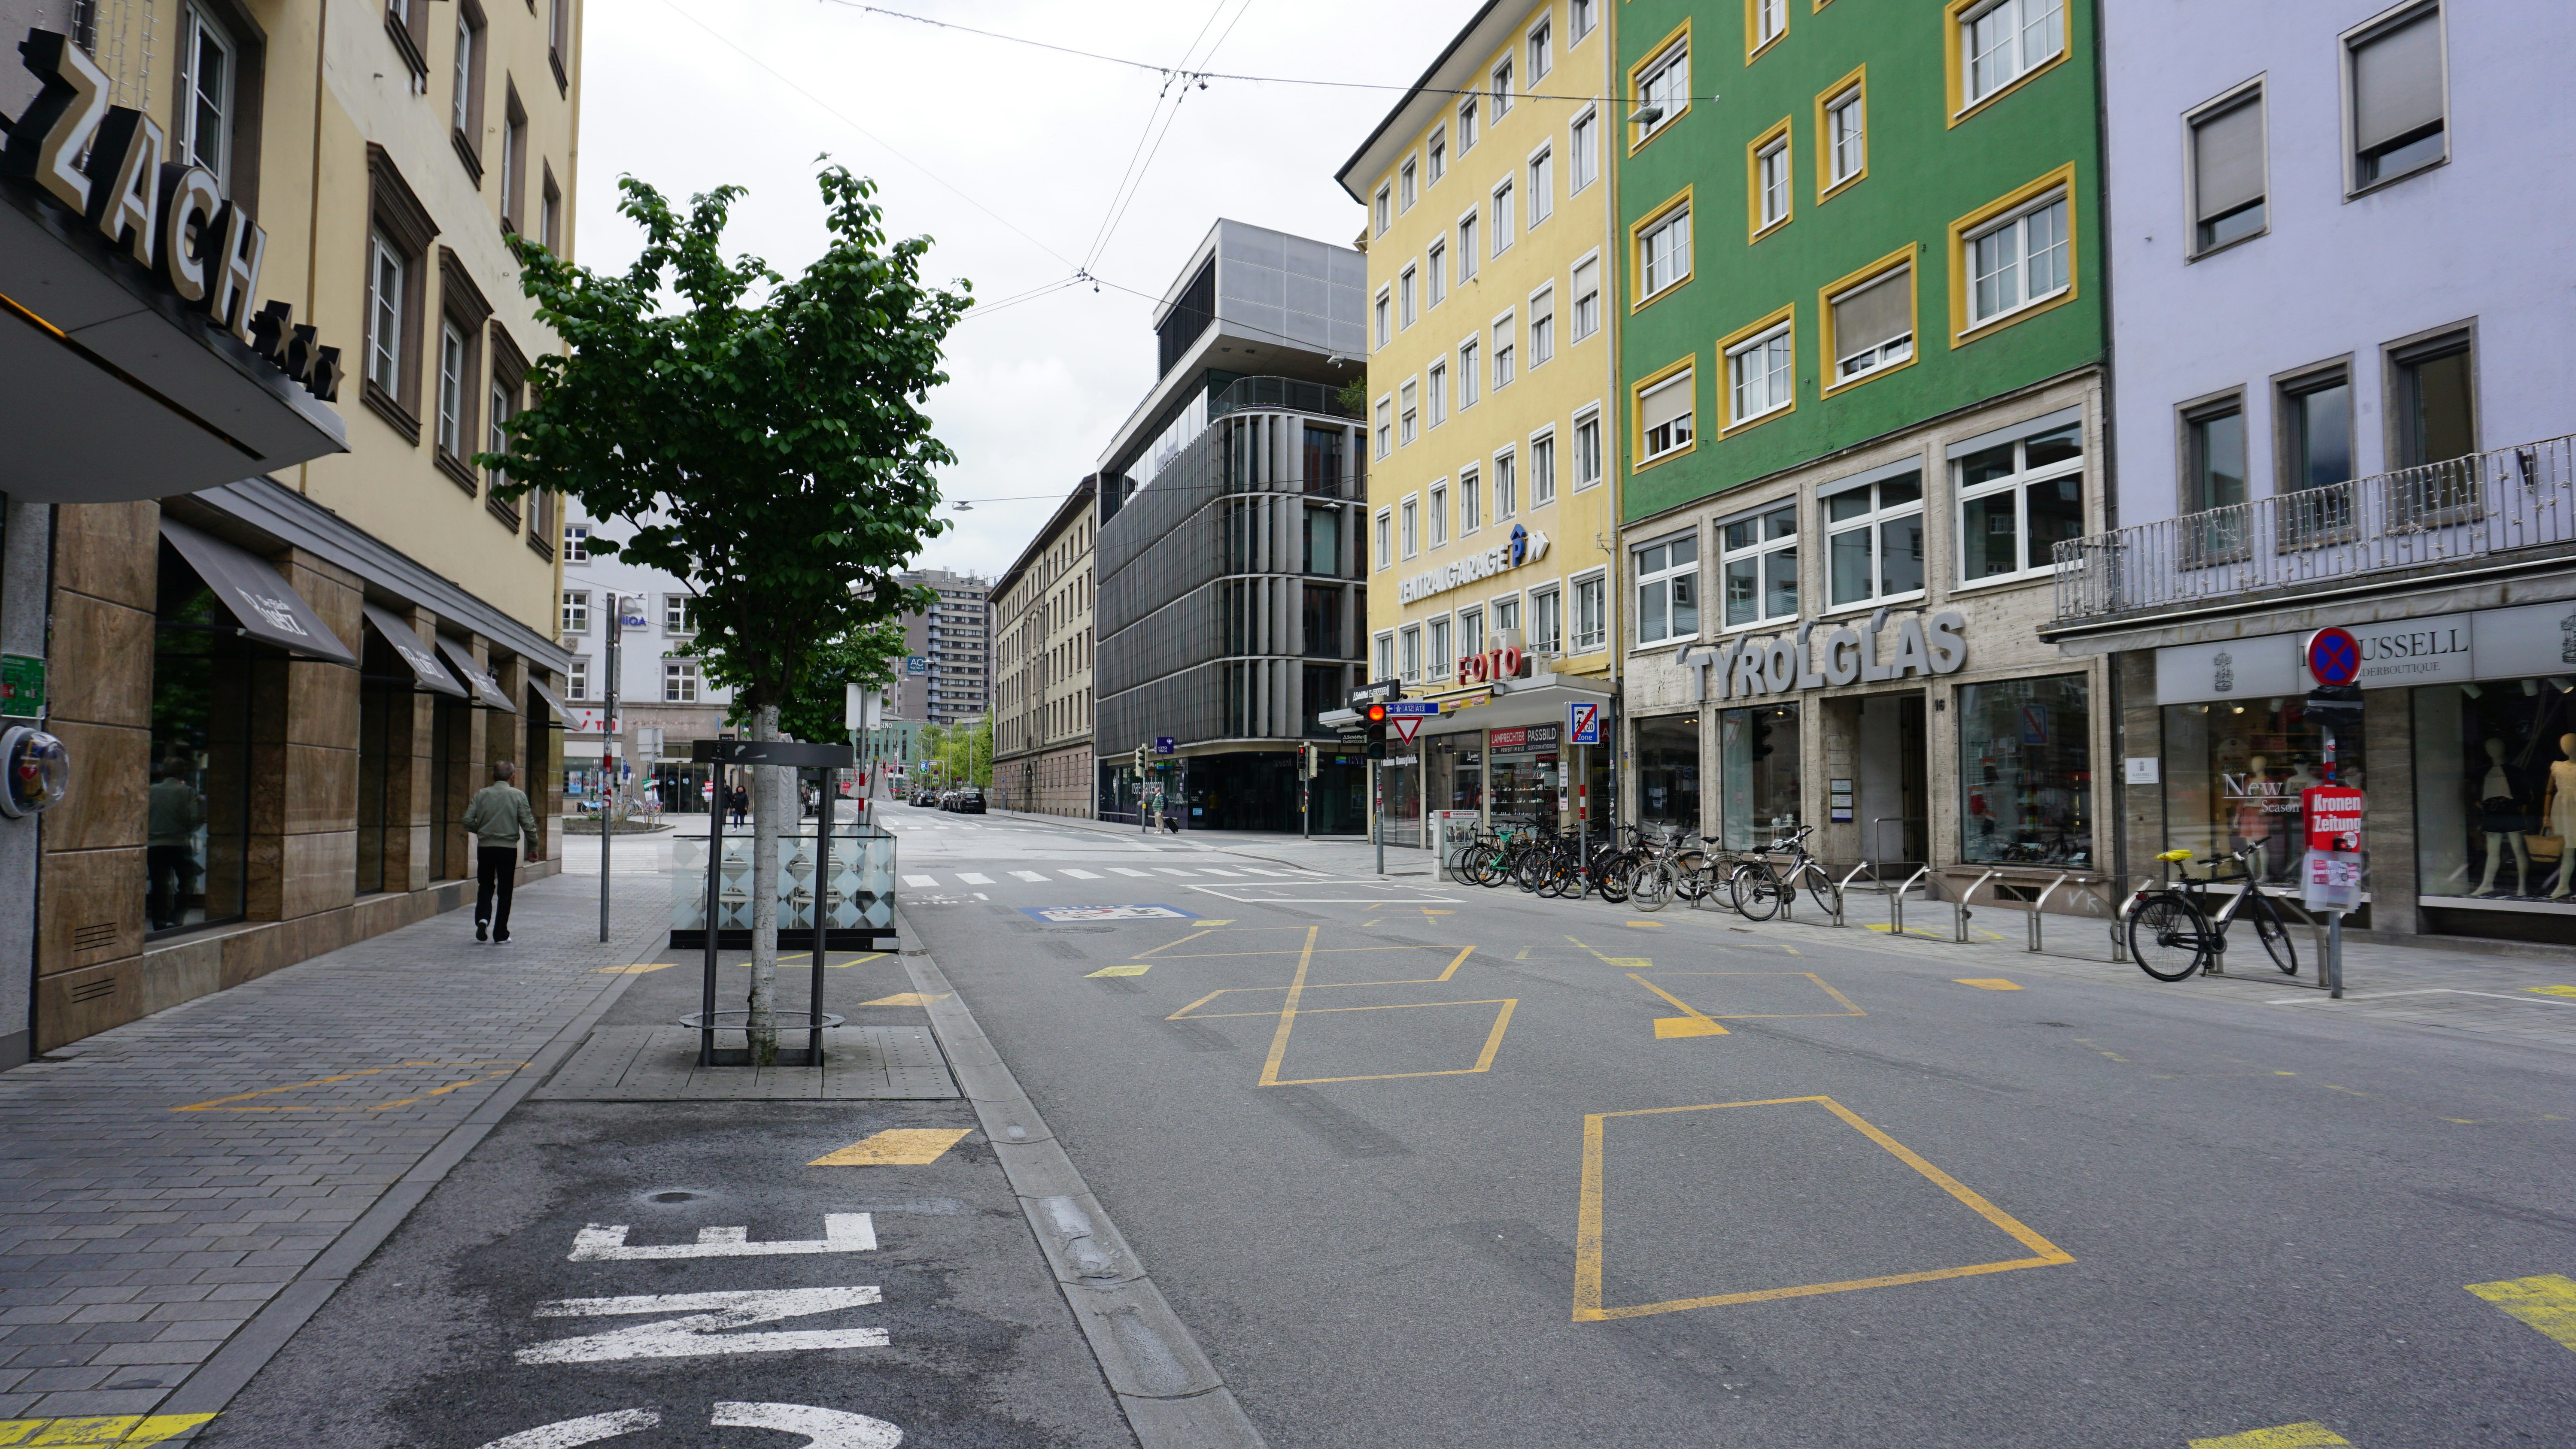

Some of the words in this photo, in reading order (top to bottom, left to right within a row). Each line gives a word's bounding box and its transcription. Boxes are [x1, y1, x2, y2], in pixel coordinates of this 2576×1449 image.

[26, 28, 266, 341] ZACH
[1398, 543, 1508, 605] ZENTRALGARAGE
[622, 615, 647, 626] IQA
[1458, 646, 1522, 685] FOTO
[1687, 612, 1967, 701] TYROLGLAS
[2360, 662, 2441, 677] DERBOUTIQUE
[1935, 699, 1945, 711] 16
[1492, 731, 1525, 744] LAMPRECHTER
[1528, 728, 1556, 742] PASSBILD
[2223, 773, 2283, 795] New
[2261, 800, 2300, 812] Season
[2314, 794, 2361, 812] Kronen
[2313, 814, 2361, 834] Zeitung
